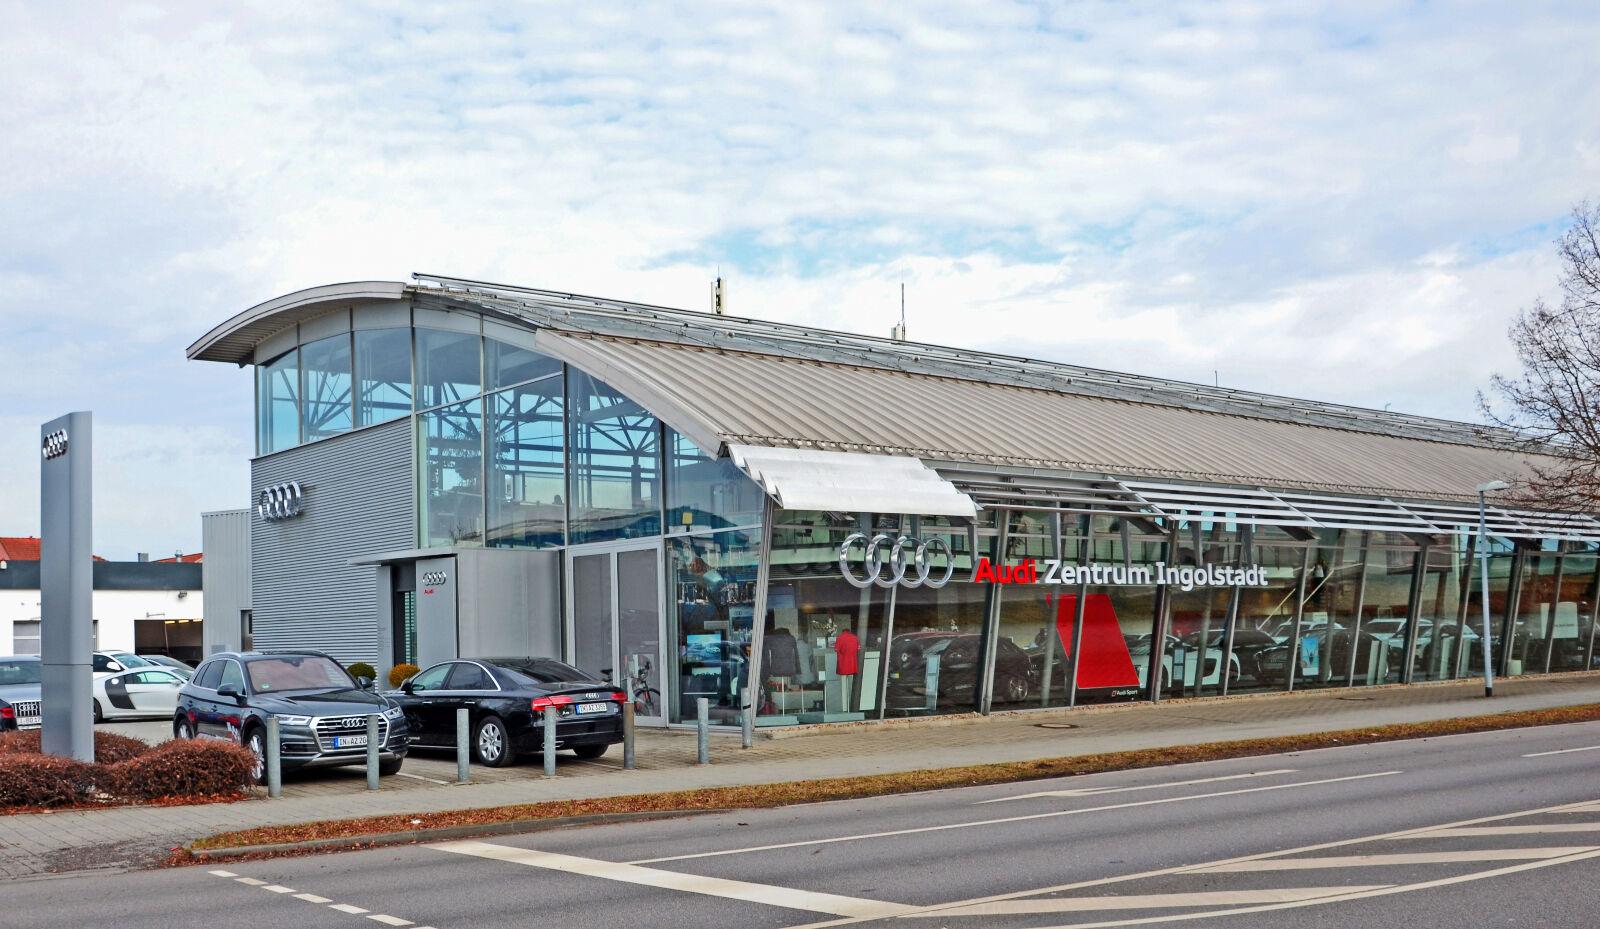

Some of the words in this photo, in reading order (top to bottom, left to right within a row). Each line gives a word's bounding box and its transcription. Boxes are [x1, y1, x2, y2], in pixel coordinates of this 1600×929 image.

[974, 557, 1037, 584] Audi
[1043, 559, 1150, 585] Zentrum
[1155, 561, 1268, 592] Ingolstadt
